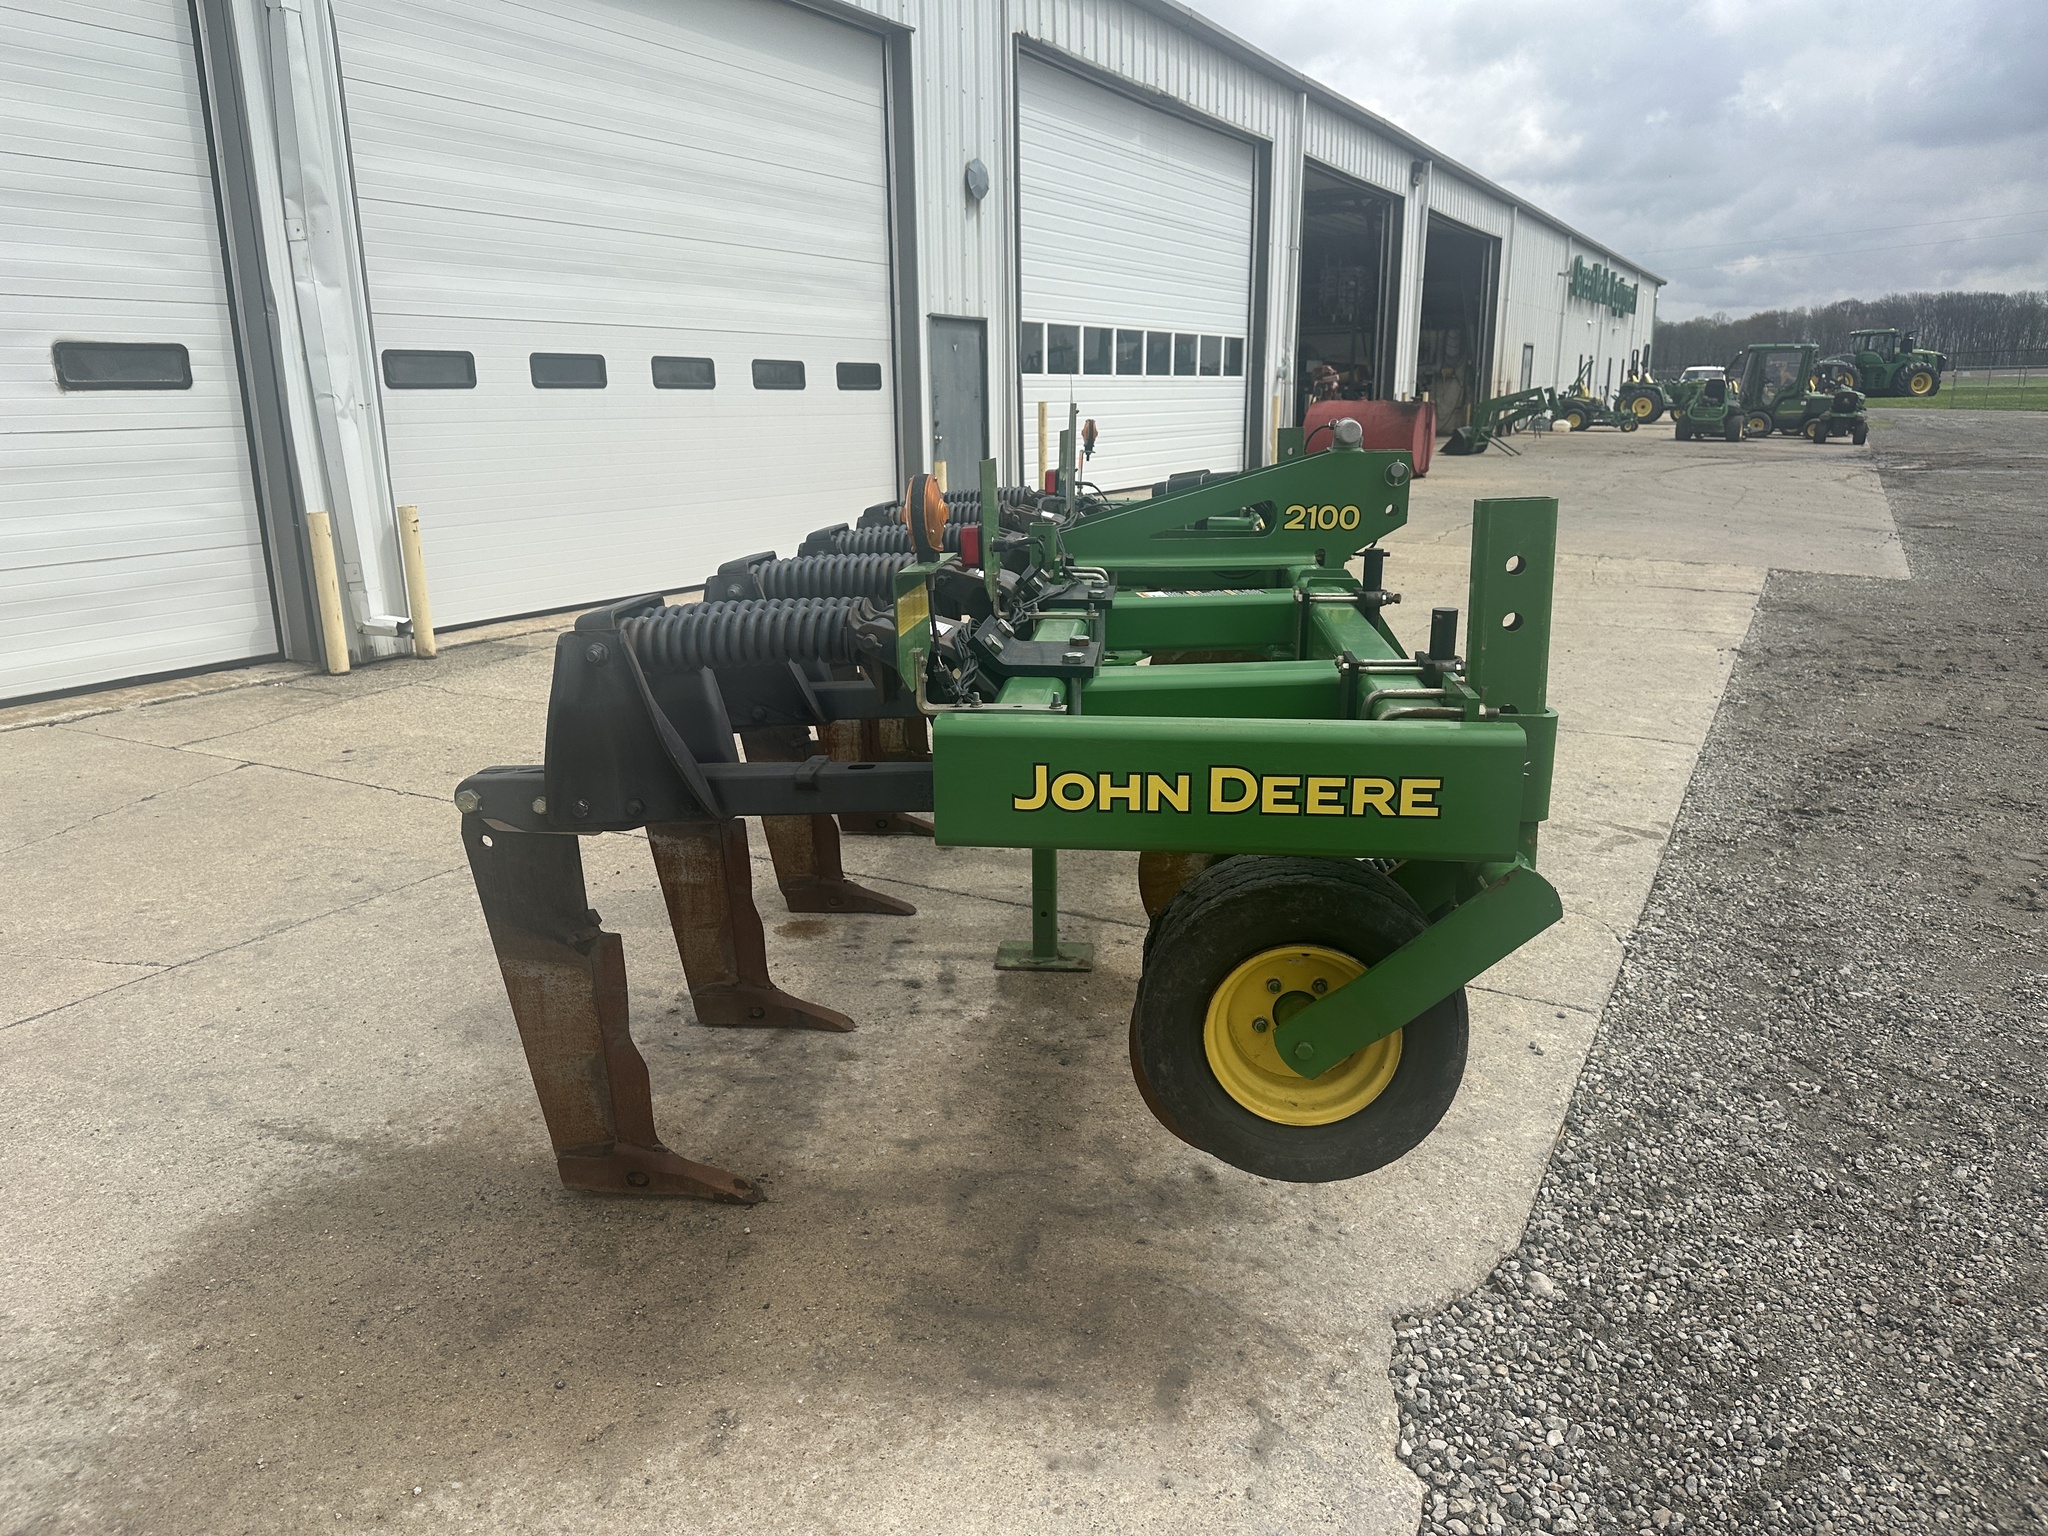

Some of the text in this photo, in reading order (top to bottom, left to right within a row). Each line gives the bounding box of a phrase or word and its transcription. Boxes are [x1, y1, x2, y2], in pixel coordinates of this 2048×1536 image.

[1283, 503, 1361, 530] 2100
[1012, 763, 1444, 819] JOHN DEERE
